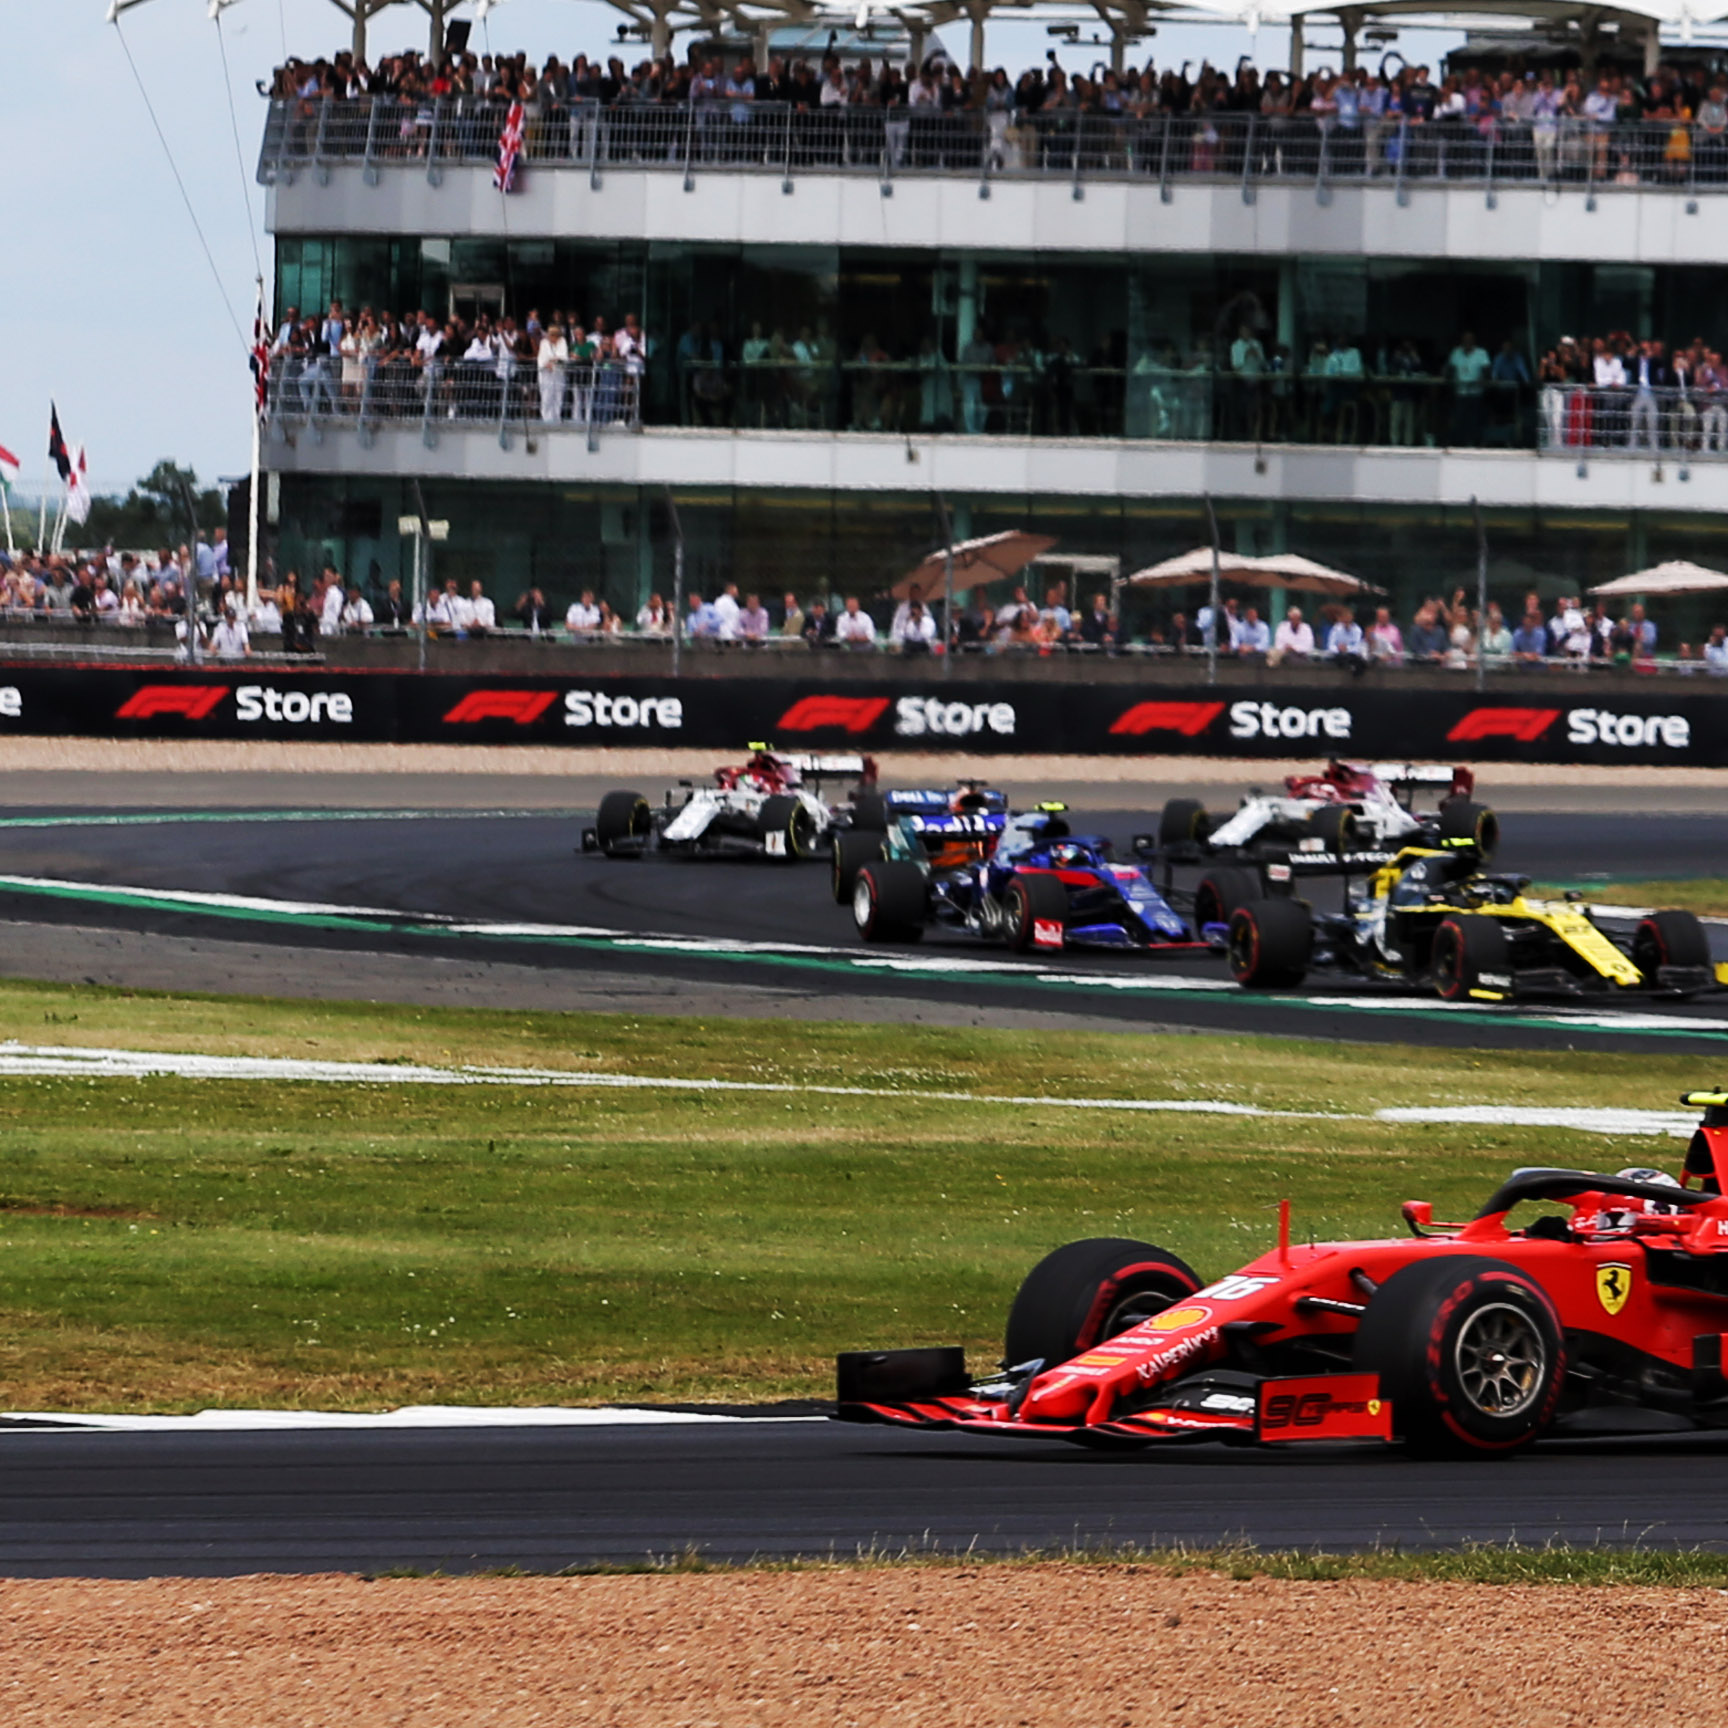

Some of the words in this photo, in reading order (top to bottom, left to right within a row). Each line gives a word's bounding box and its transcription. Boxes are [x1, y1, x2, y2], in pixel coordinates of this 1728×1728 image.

[236, 686, 353, 723] Store
[565, 691, 683, 728] Store
[897, 697, 1016, 736] Store
[1231, 702, 1352, 738] Store
[1568, 709, 1690, 748] Store
[1192, 1273, 1282, 1301] 16
